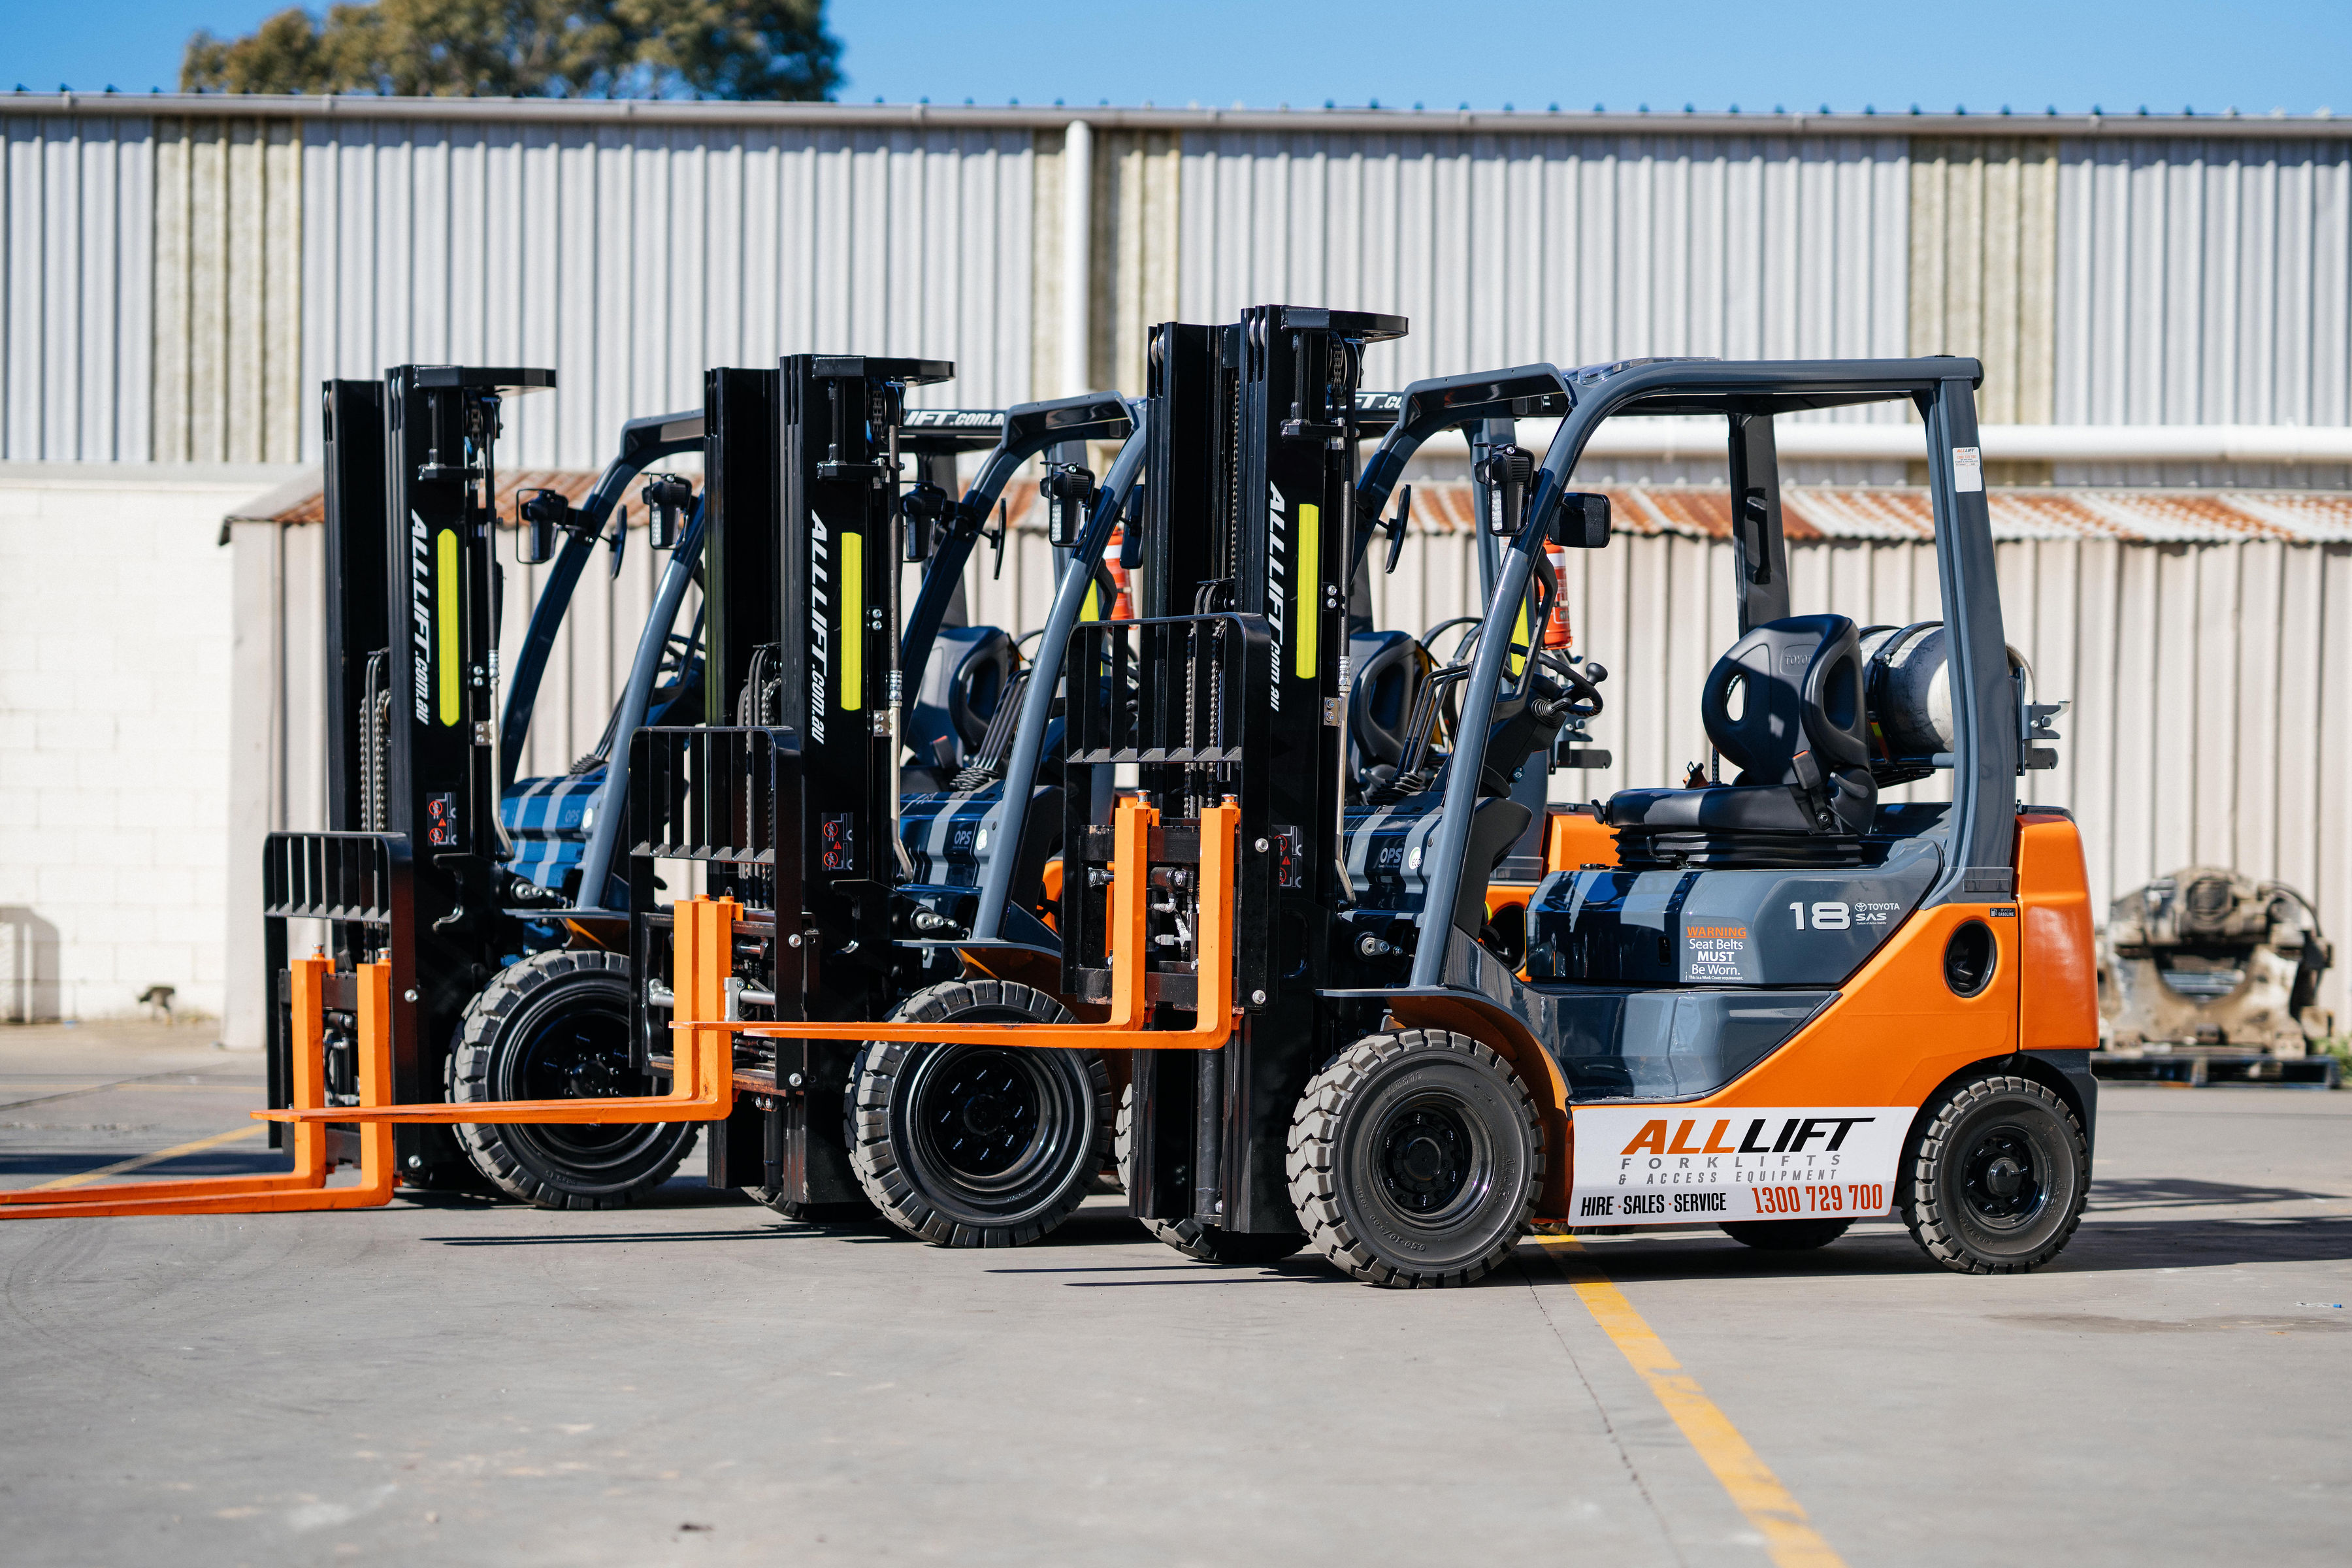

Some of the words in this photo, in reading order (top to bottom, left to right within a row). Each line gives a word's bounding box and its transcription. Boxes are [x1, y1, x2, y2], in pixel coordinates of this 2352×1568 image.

[904, 411, 1005, 426] IFT.com.a
[412, 508, 431, 726] ALLLIFT.com.au
[811, 509, 827, 744] ALLLIFT.com.au
[1784, 654, 1812, 666] TOYOT
[565, 809, 581, 823] OPS
[954, 830, 972, 845] OPS
[1380, 847, 1403, 863] OPS
[1789, 902, 1850, 930] 18
[1855, 913, 1887, 921] SAS
[1687, 926, 1746, 937] WARNING
[1689, 938, 1714, 949] Seat
[1716, 939, 1743, 950] Belts
[1697, 951, 1735, 962] MUST
[1691, 964, 1705, 975] Be
[1707, 964, 1740, 975] Worn.
[1620, 1117, 1876, 1154] ALLLIFT
[1621, 1154, 1840, 1169] FORKLIFTS
[1619, 1174, 1626, 1185] &
[1646, 1171, 1717, 1184] ACCESS
[1735, 1169, 1837, 1183] EQUIPMENT
[1580, 1196, 1614, 1217] HIRE
[1623, 1194, 1665, 1215] SALES
[1674, 1192, 1727, 1213] SERVICE
[1752, 1186, 1799, 1213] 1300
[1805, 1184, 1843, 1211] 729
[1848, 1184, 1882, 1210] 700
